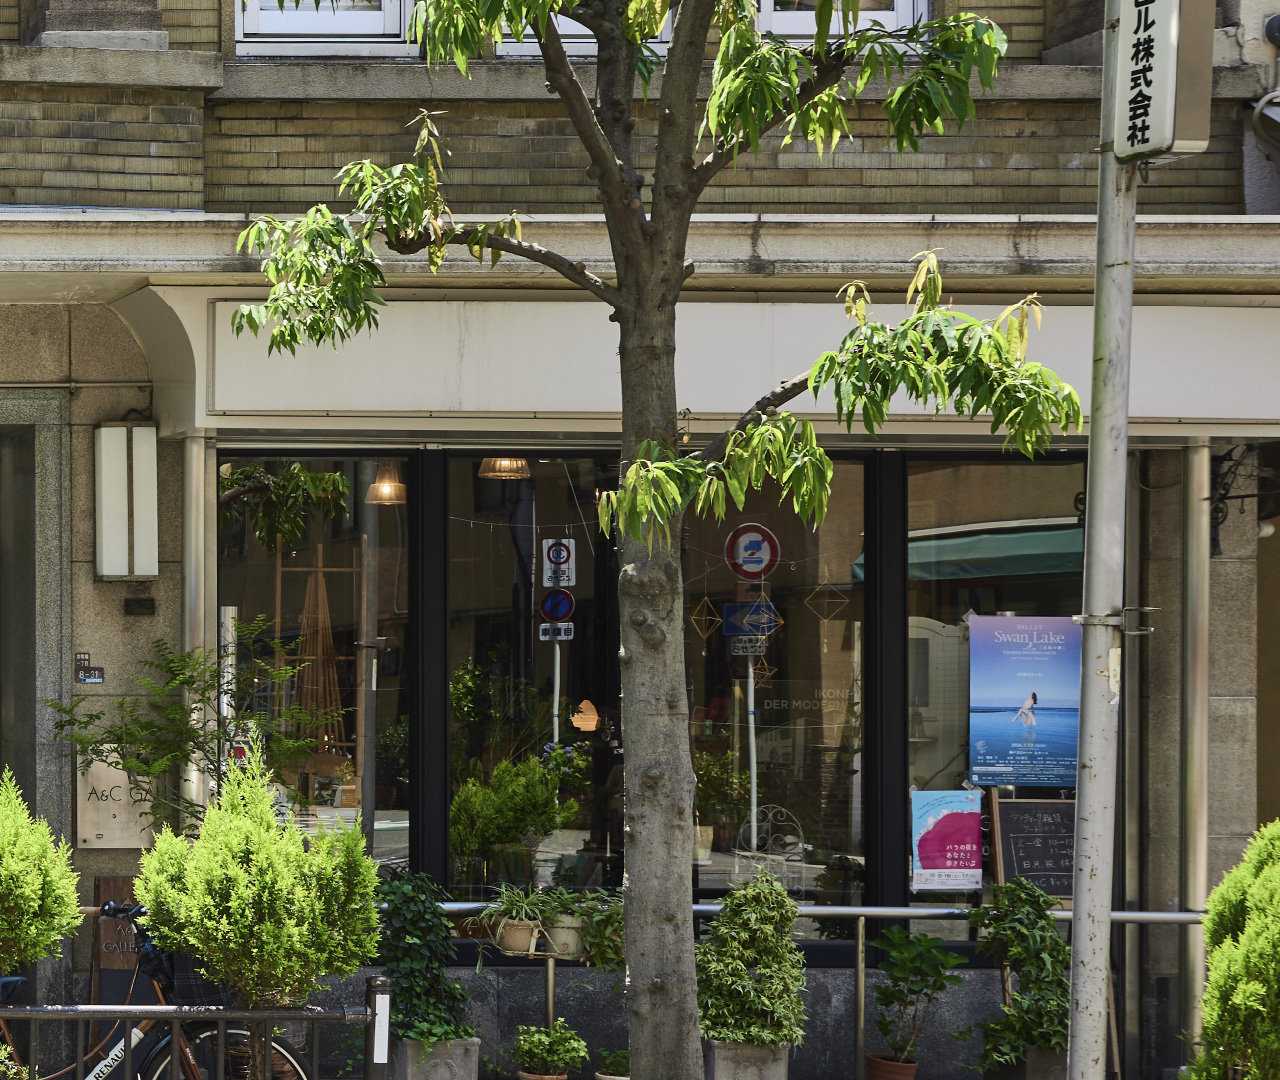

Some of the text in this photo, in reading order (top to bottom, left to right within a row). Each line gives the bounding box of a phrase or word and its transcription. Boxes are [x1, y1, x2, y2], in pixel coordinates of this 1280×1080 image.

[994, 630, 1065, 644] Swan Lake
[87, 785, 122, 802] A&C
[92, 1045, 127, 1080] RENAU
